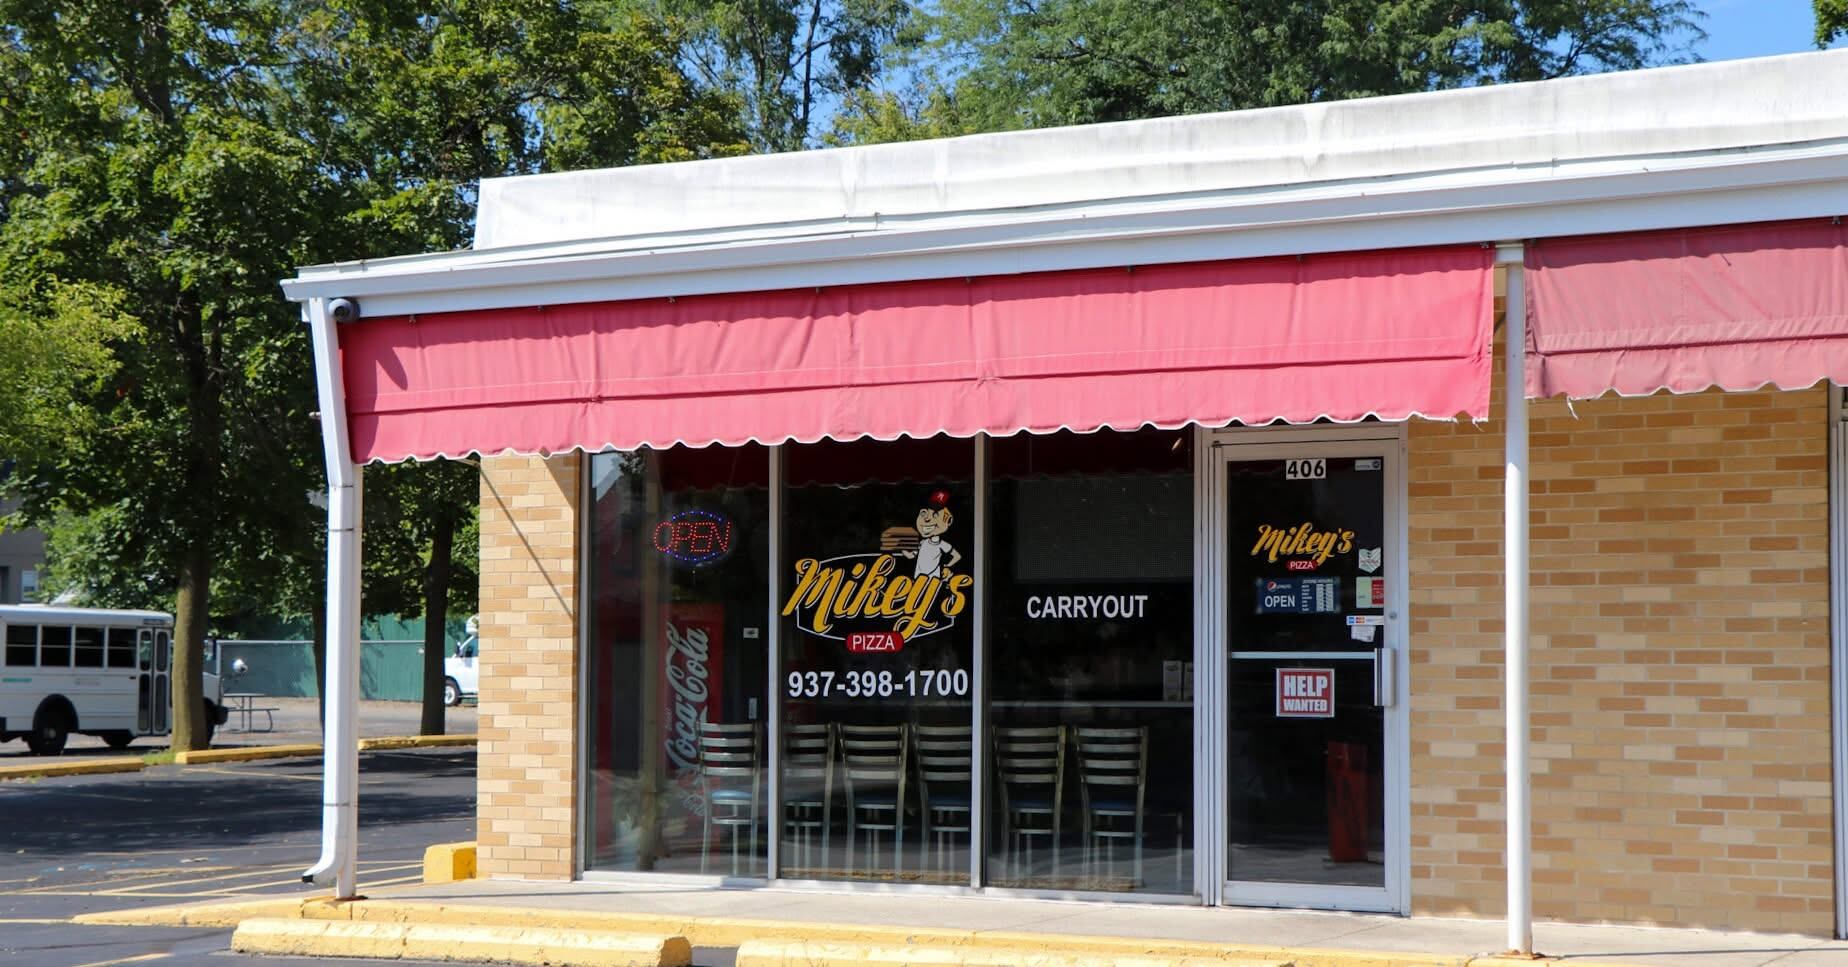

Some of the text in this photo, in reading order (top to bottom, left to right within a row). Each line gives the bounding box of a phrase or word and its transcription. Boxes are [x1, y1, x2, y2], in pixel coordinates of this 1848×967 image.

[1288, 460, 1325, 478] 406
[654, 521, 731, 552] OPEN
[1251, 522, 1355, 566] Mikey's
[1289, 560, 1314, 570] PIZZA
[782, 554, 974, 643] Mikey's
[1027, 595, 1148, 618] CARRYOUT
[1264, 595, 1296, 608] OPEN
[852, 634, 895, 650] PIZZA
[788, 669, 968, 698] 937-398-1700
[1284, 675, 1328, 697] HELP
[1283, 698, 1328, 712] WANTED
